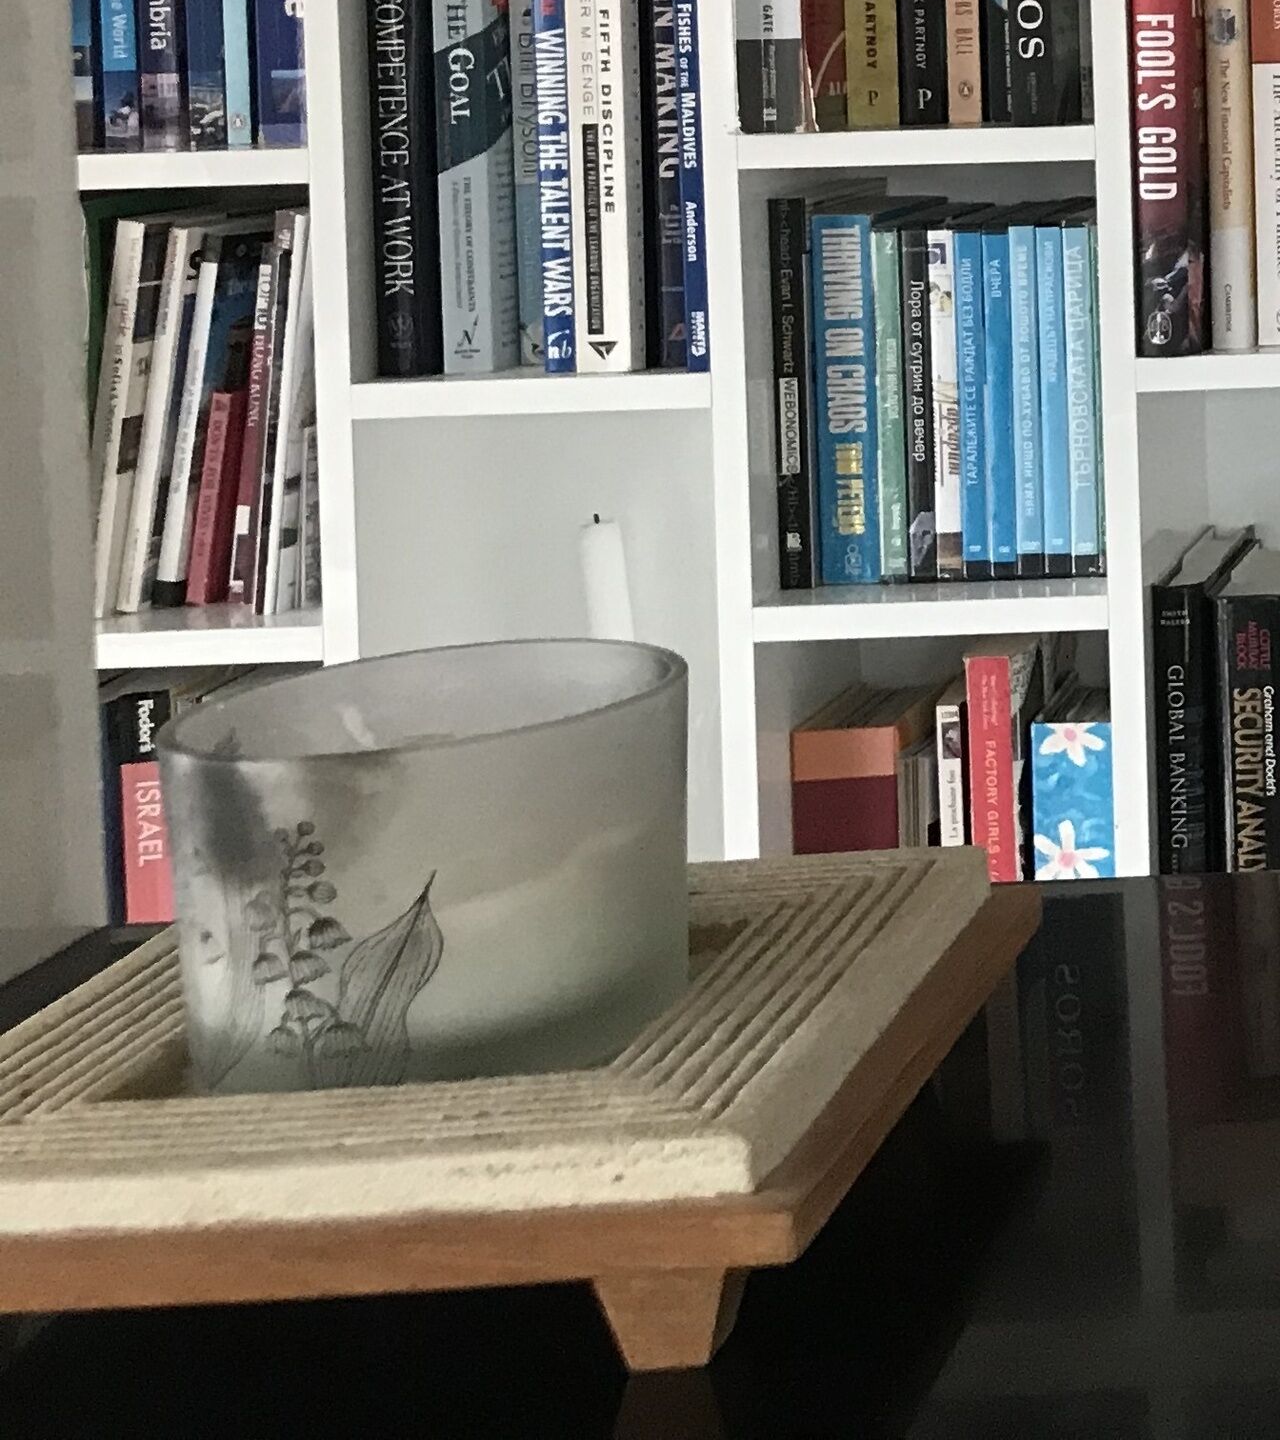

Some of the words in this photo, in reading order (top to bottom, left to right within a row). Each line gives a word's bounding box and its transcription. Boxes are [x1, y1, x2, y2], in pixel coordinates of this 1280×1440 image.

[599, 7, 610, 66] FIFTH
[913, 7, 927, 70] PARTNOY
[1136, 13, 1176, 113] FOOL'S
[533, 28, 564, 125] WINNING
[538, 128, 567, 166] THE
[601, 82, 615, 214] DISCIPLINE
[1138, 125, 1178, 202] GOLD
[381, 171, 411, 211] AT
[539, 170, 570, 248] TALENT
[383, 212, 414, 297] WORK
[541, 249, 572, 317] WARS
[821, 225, 864, 320] THRIVING
[1065, 244, 1088, 331] ЦАРИЦА
[909, 279, 924, 318] Лора
[911, 321, 922, 338] от
[823, 328, 865, 356] ON
[908, 341, 923, 393] сутрин
[825, 362, 867, 435] CHAOS
[911, 396, 924, 416] до
[1070, 339, 1091, 490] ТЪРНОВСКАТА
[911, 418, 926, 463] вечер
[1167, 665, 1185, 746] GLOBAL
[985, 740, 999, 797] FACTORY
[1169, 752, 1188, 849] BANKING
[134, 780, 162, 868] ISRAEL
[988, 802, 1001, 855] GIRLS
